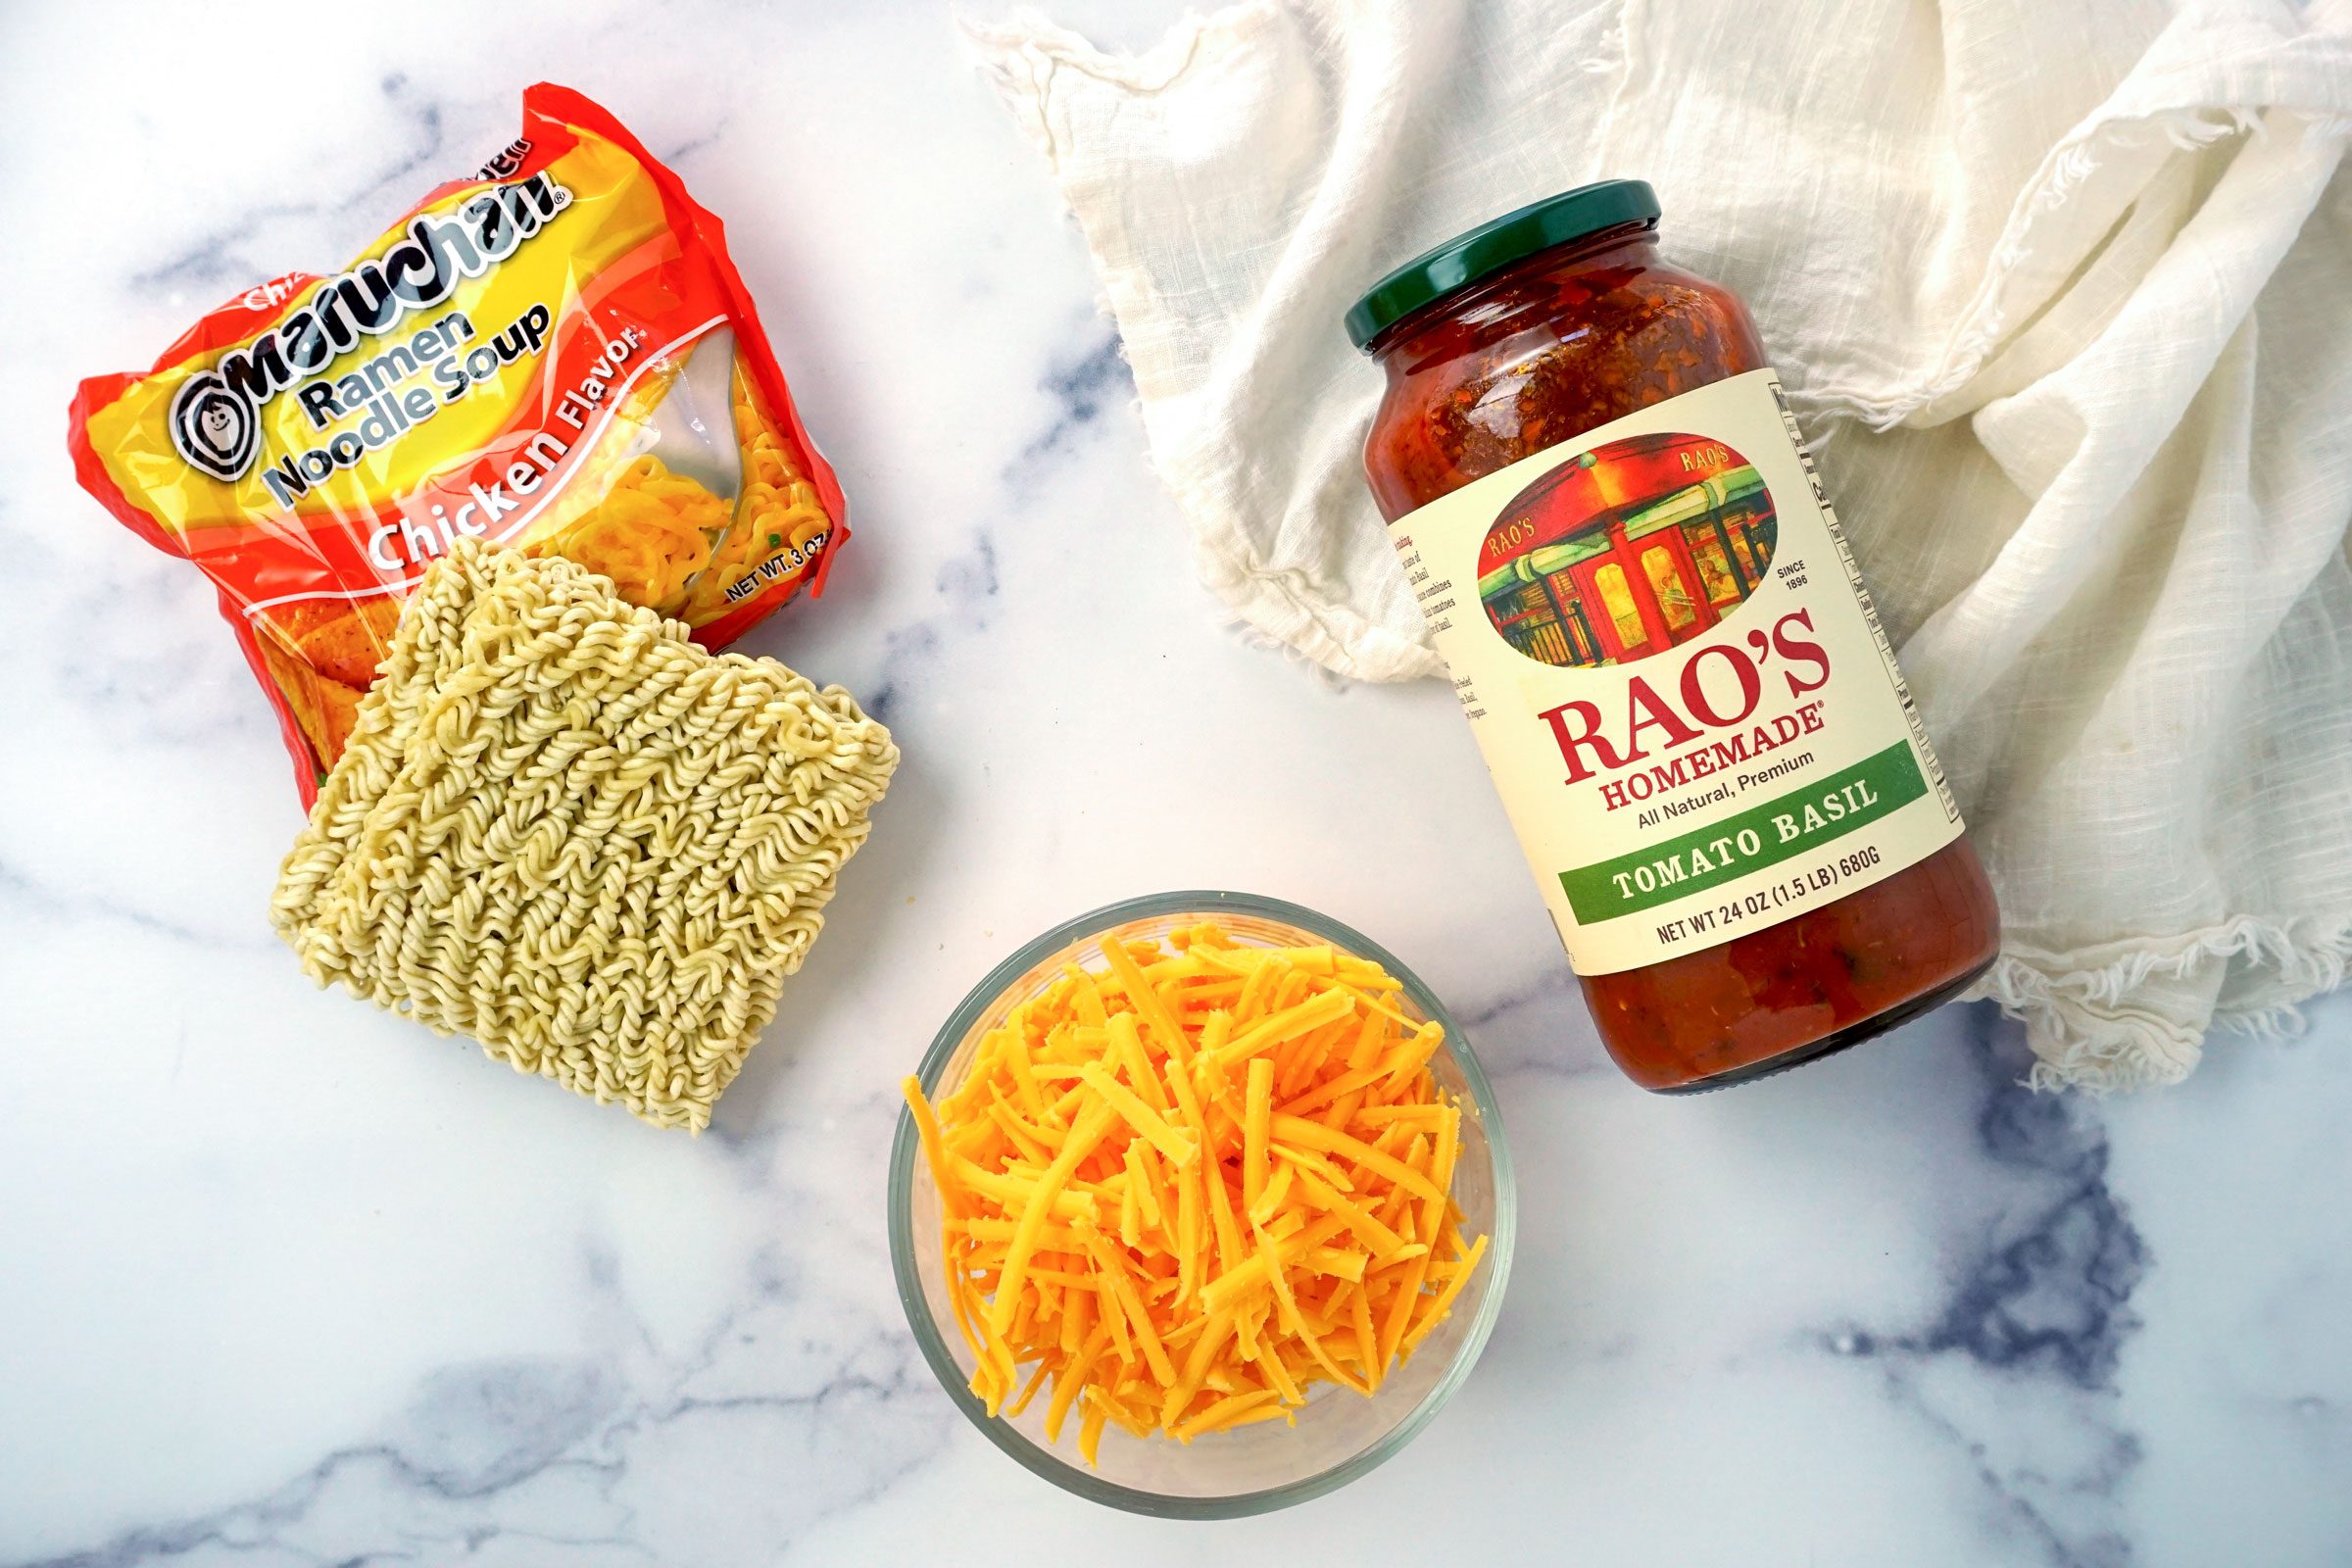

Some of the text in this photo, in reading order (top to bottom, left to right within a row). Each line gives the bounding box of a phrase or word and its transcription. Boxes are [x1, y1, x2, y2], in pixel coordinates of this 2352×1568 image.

[263, 304, 551, 509] Noodle Soup
[297, 312, 475, 429] Ramen
[368, 326, 640, 571] Chicken Flavor
[1680, 444, 1730, 472] RAO'S
[725, 571, 760, 601] NET
[759, 554, 792, 578] WT.
[791, 549, 804, 565] 3
[1487, 516, 1536, 559] RAO'S
[1777, 560, 1806, 579] SINCE
[1425, 579, 1452, 598] combines
[1430, 598, 1456, 615] tomatoes
[1786, 574, 1808, 590] 1896
[1538, 608, 1830, 785] RAO'S
[1598, 702, 1826, 812] HOMEMADE
[1638, 752, 1815, 829] All Natural, Premium
[1613, 828, 1762, 899] TOMATO
[1771, 779, 1879, 844] BASIL
[1656, 845, 1881, 945] NET WT 24 OZ (1.5 LB) 680G
